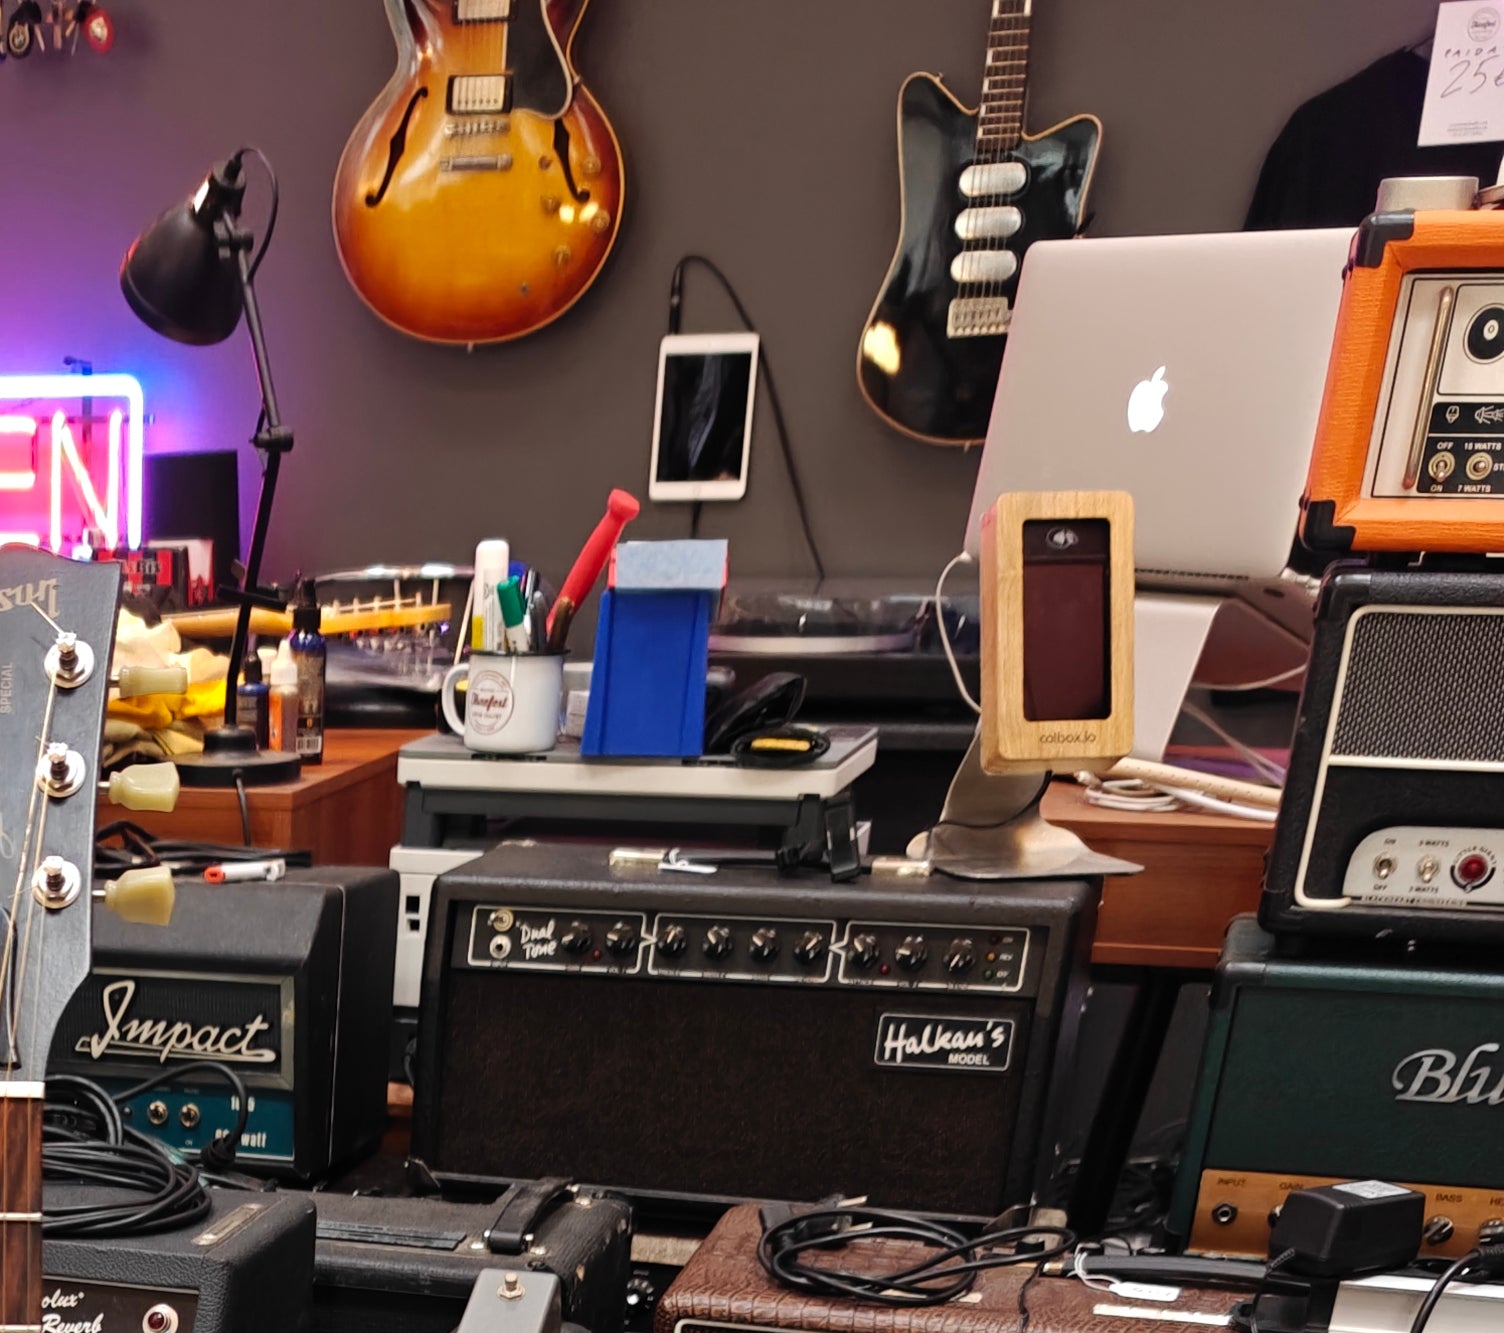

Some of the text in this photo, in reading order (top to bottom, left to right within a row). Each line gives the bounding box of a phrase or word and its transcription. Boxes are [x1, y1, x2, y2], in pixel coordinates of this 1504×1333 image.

[1436, 441, 1454, 451] OFF
[1474, 442, 1502, 451] WATTS
[1430, 484, 1443, 493] ON
[1463, 485, 1491, 493] WATTS
[0, 662, 14, 715] SPECIAL
[519, 917, 555, 943] Dual
[522, 943, 557, 961] Tone
[75, 979, 276, 1064] Impact
[948, 1052, 990, 1066] MODEL
[241, 1130, 267, 1149] watt
[1217, 1177, 1246, 1187] INPUT
[1435, 1193, 1463, 1203] BASS
